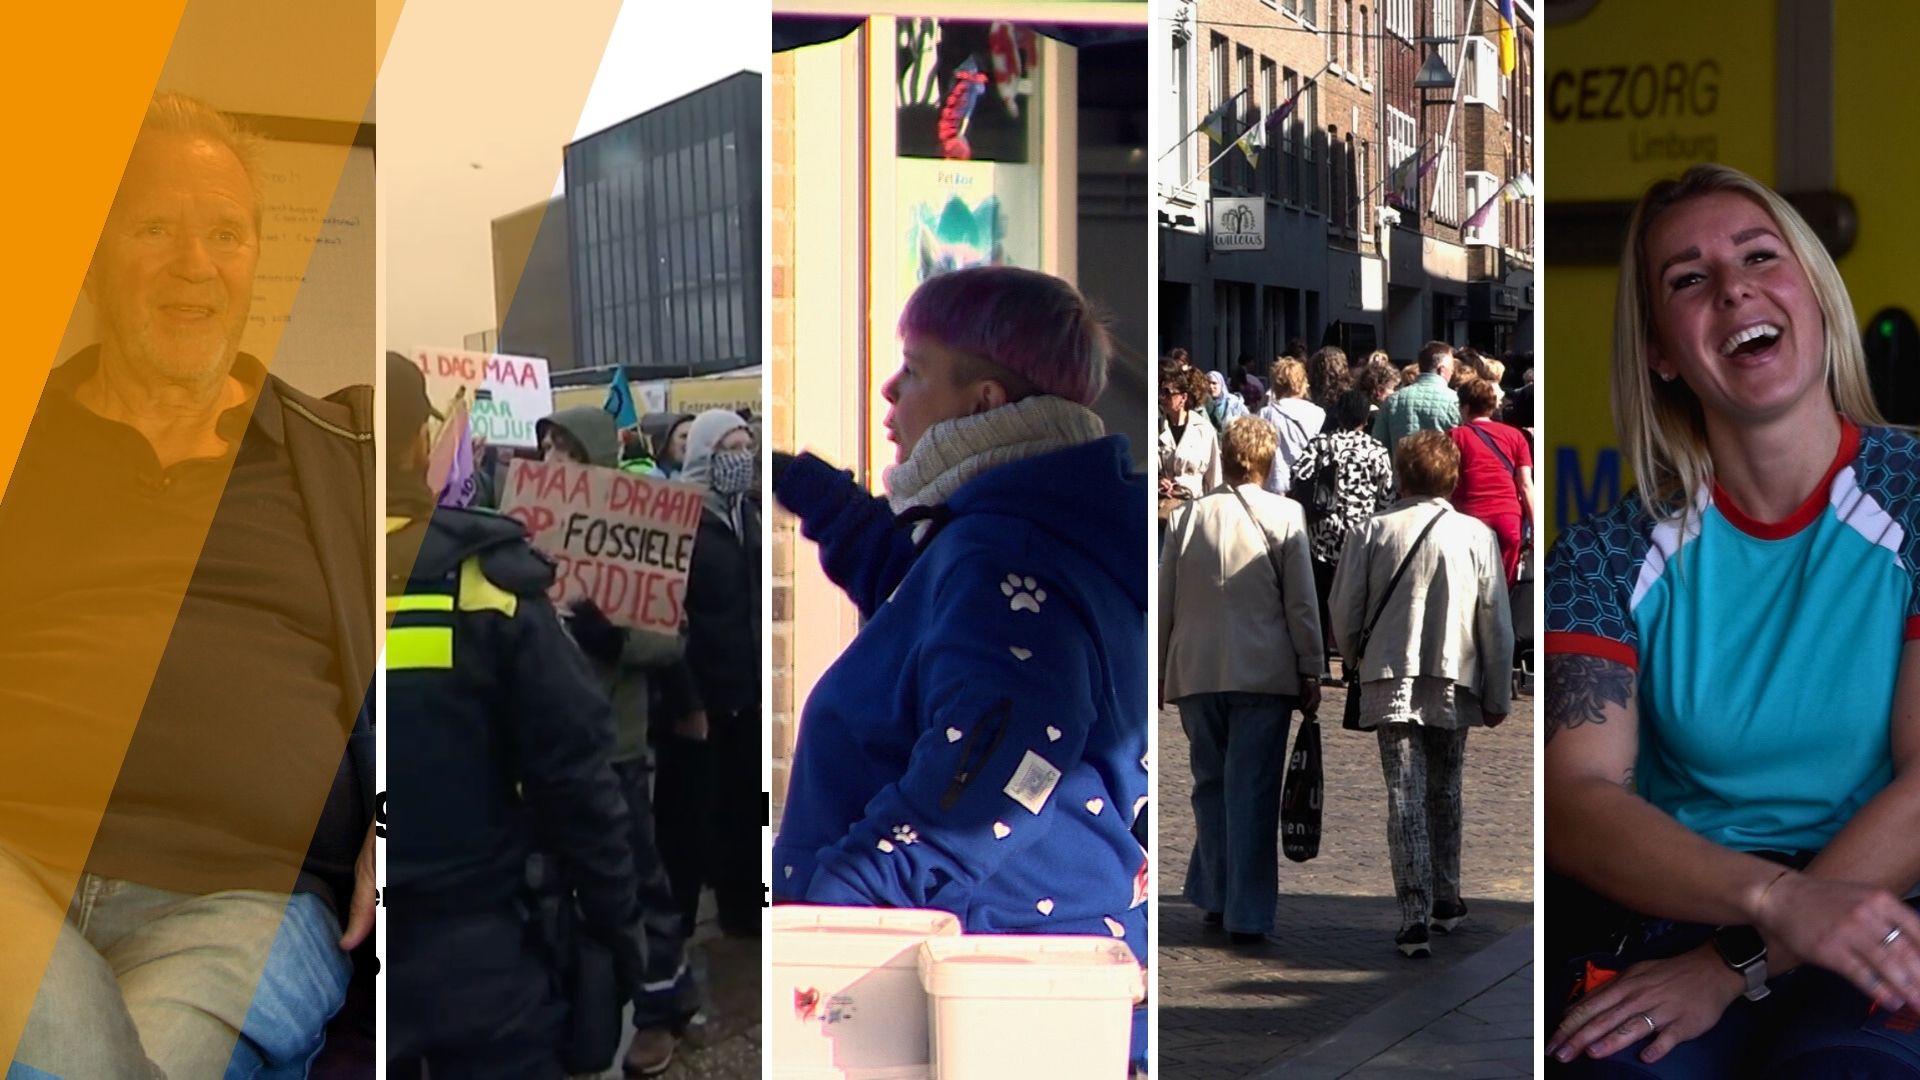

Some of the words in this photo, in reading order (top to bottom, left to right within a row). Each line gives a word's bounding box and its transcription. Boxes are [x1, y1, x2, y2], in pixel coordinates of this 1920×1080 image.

[1544, 58, 1720, 122] CEZORG
[1628, 130, 1719, 163] Limburg
[437, 355, 476, 381] DAG
[481, 358, 538, 390] MAA
[515, 461, 591, 508] MAA
[564, 512, 693, 573] FOSSIELE
